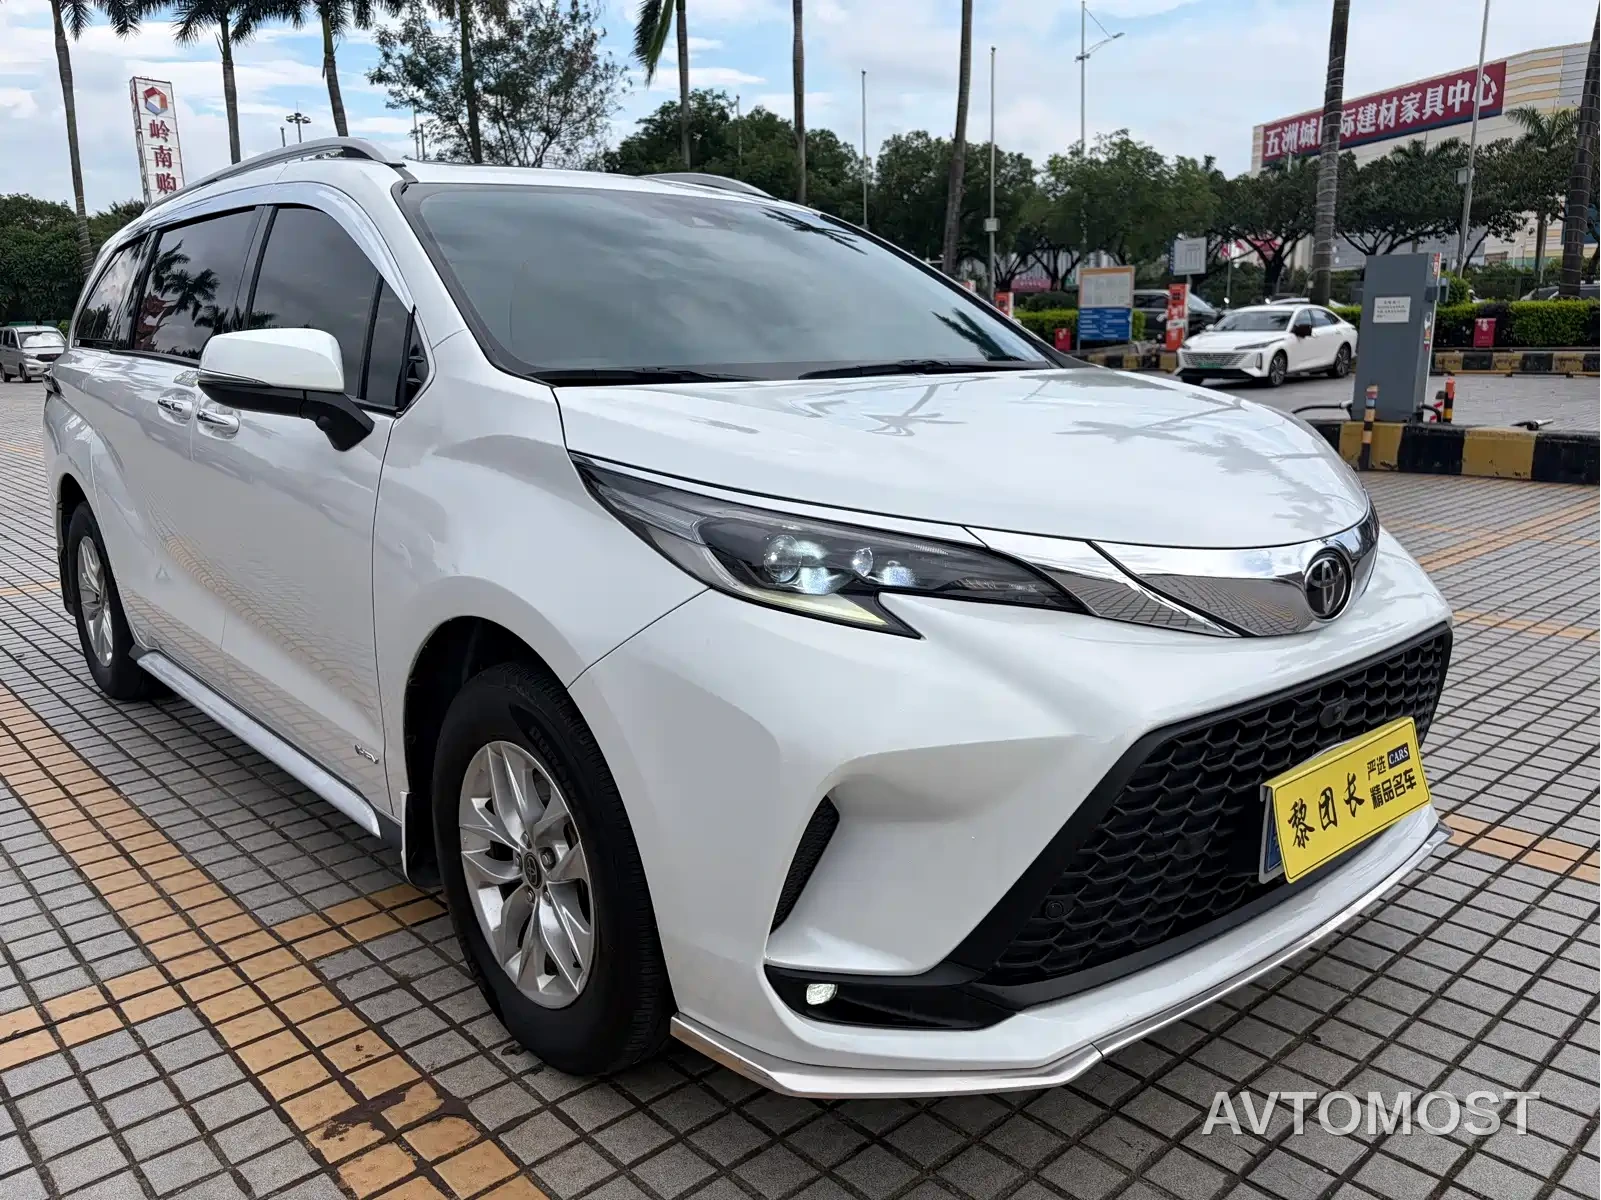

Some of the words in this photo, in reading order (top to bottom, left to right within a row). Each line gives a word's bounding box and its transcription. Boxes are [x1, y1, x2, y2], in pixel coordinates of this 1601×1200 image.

[1264, 73, 1498, 158] 五洲城际建材家具中心
[149, 119, 177, 195] 岭南购
[1366, 754, 1387, 781] 严选
[1388, 746, 1409, 766] CARS
[1369, 767, 1417, 810] 精品名车
[1287, 772, 1366, 850] 黎团长
